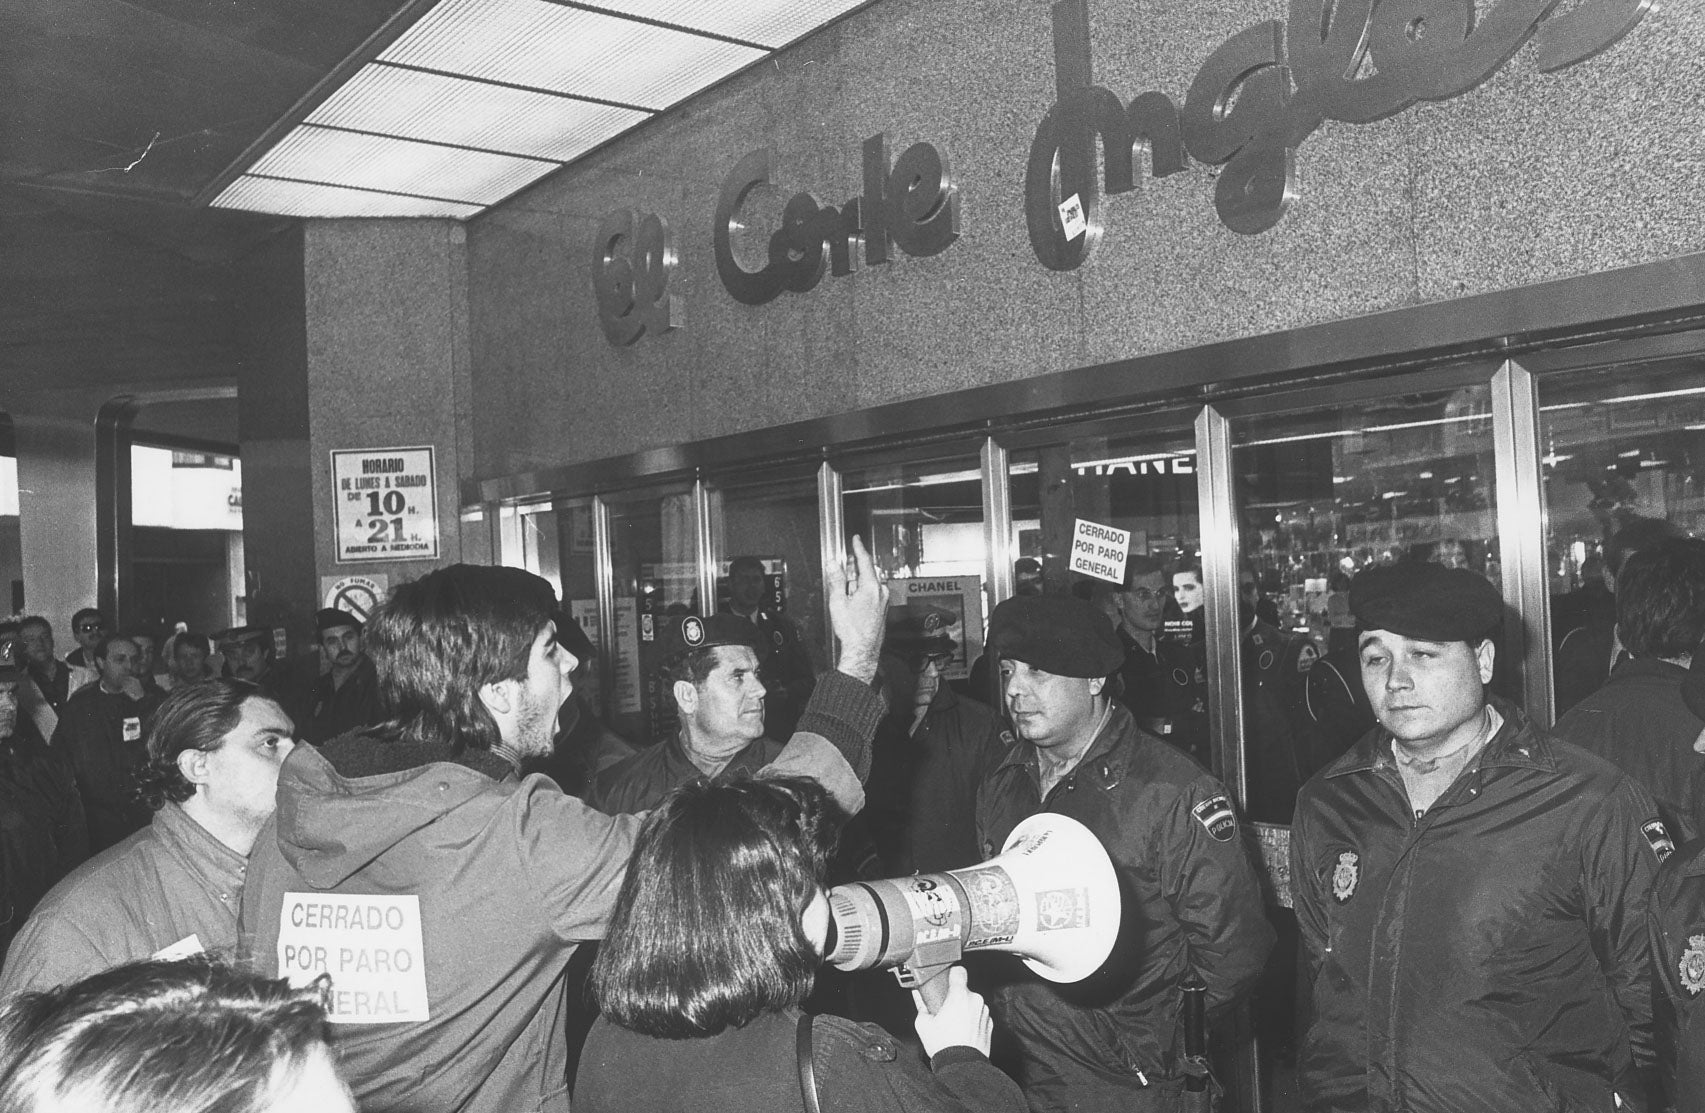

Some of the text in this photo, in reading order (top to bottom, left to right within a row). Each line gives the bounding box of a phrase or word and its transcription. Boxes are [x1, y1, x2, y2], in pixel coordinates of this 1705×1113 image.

[592, 206, 684, 347] El
[713, 131, 961, 305] Corte
[362, 458, 405, 475] HORARIO
[341, 474, 427, 490] DE LUNES A SABADO
[347, 492, 361, 501] DE
[366, 490, 406, 516] 10
[355, 519, 363, 528] A
[367, 517, 408, 543] 21
[1079, 523, 1125, 545] CERRADO
[345, 543, 429, 554] ABIERTO A MEDIODIA
[1075, 539, 1125, 563] POR PARO
[1075, 557, 1119, 580] GENERAL
[335, 578, 376, 591] NO FUMAR
[908, 581, 962, 593] CHANEL
[291, 902, 404, 930] CERRADO
[284, 944, 413, 973] POR PARO
[323, 989, 409, 1016] NERAL
